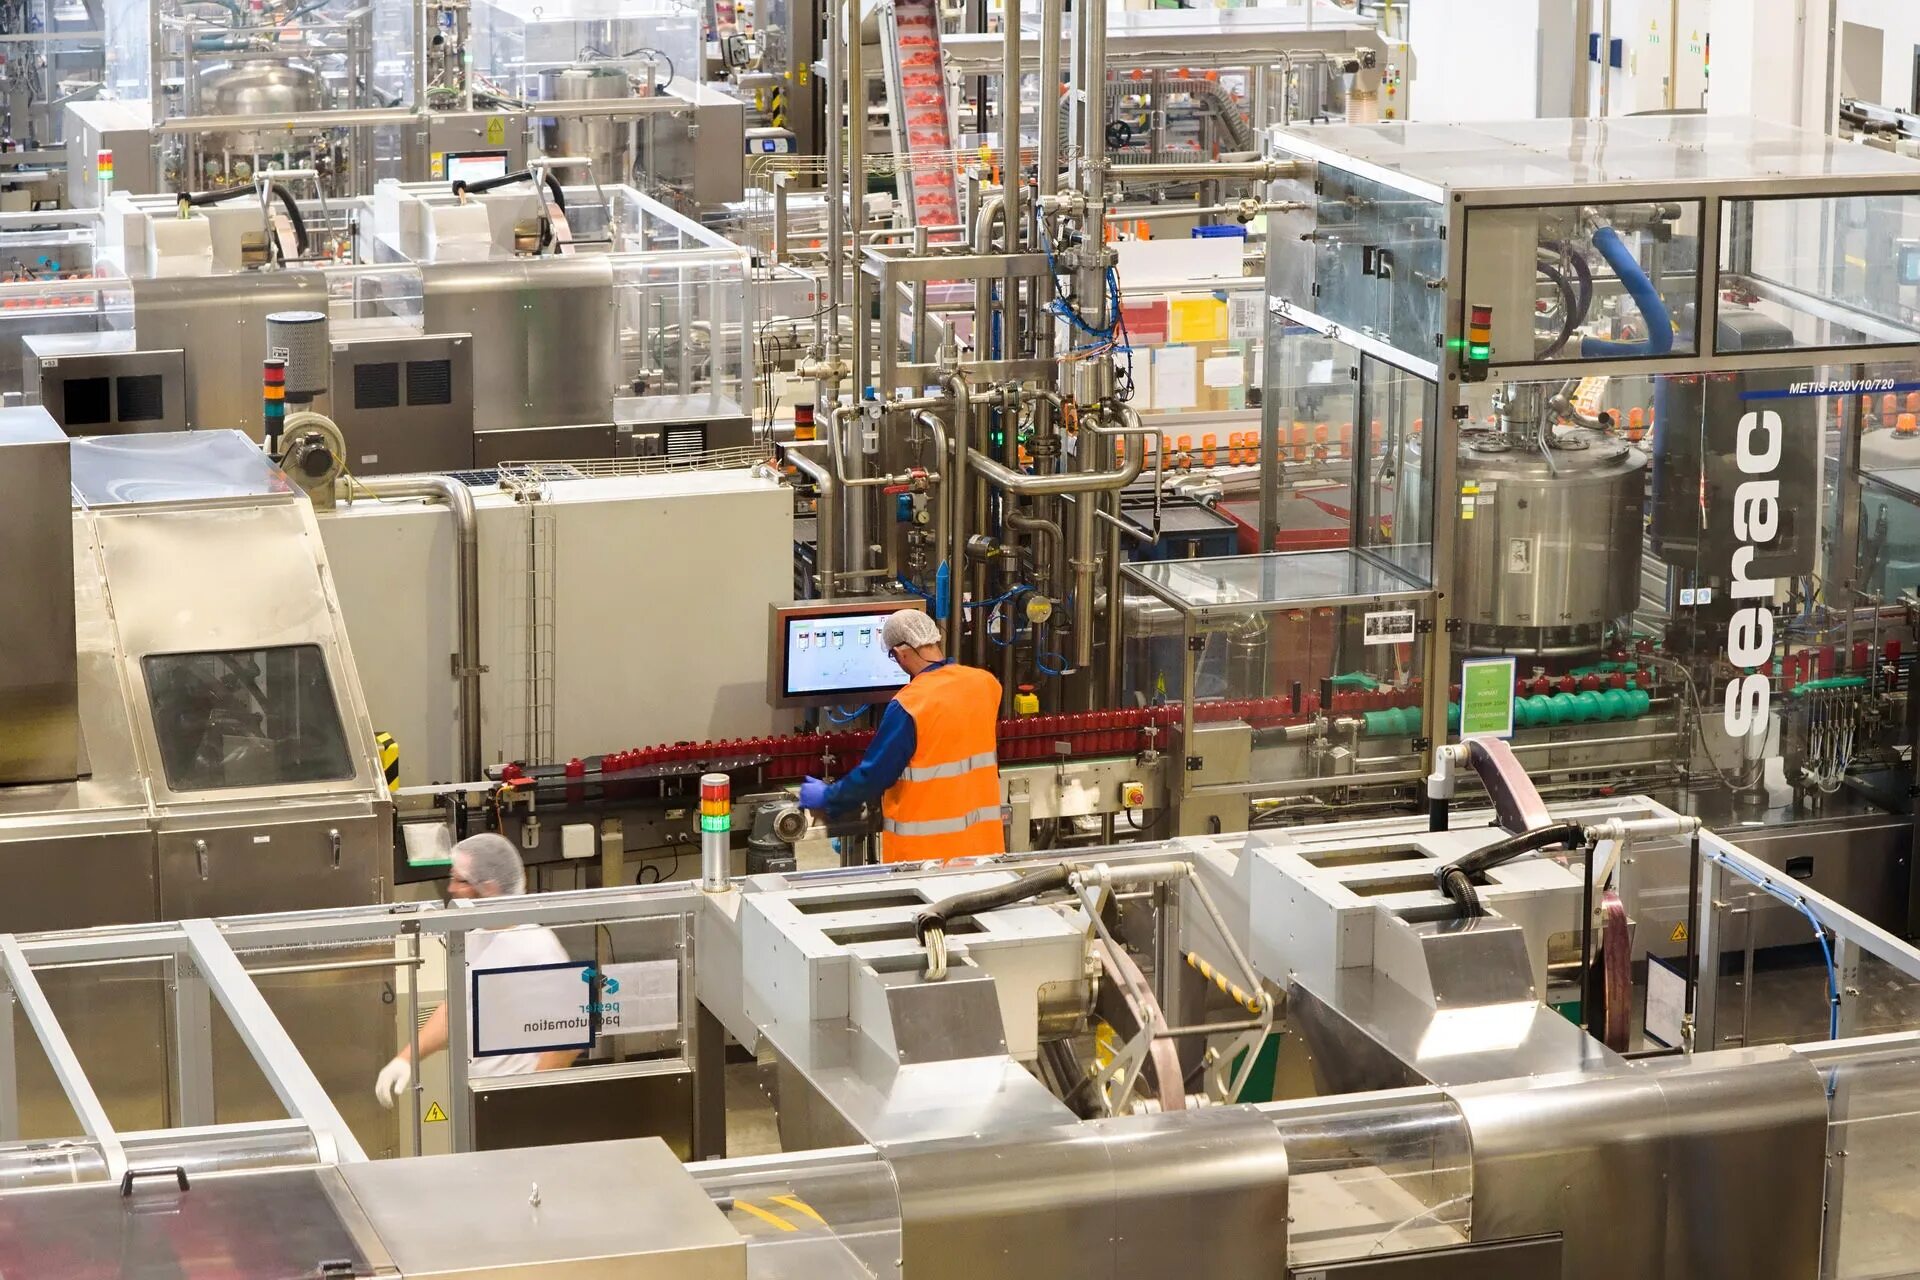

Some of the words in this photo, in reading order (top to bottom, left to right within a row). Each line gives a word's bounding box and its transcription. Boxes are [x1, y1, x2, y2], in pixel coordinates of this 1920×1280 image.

[1789, 381, 1826, 395] METIS
[1829, 378, 1895, 393] R20V10/720
[1724, 409, 1783, 738] serac
